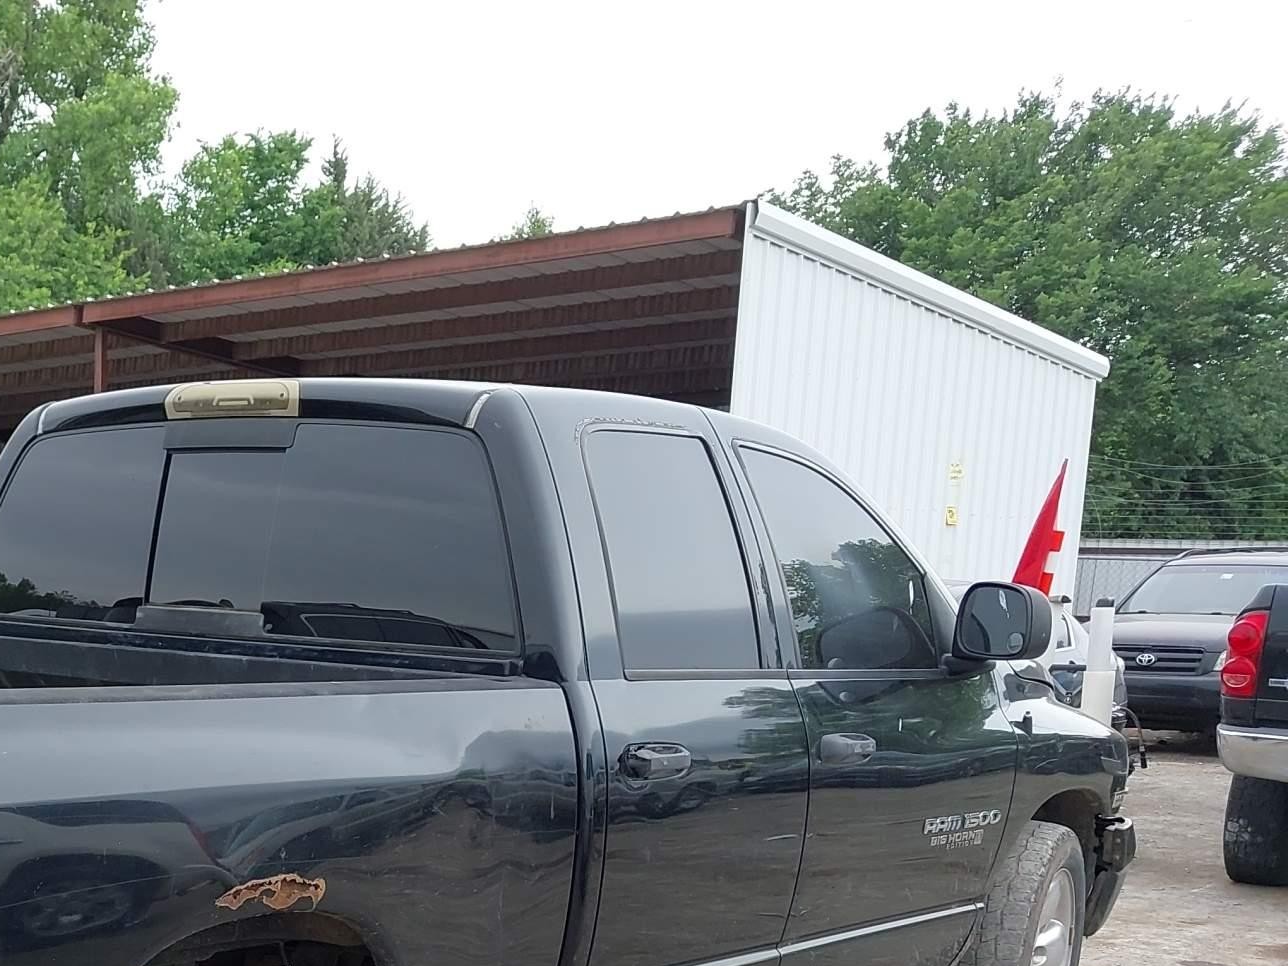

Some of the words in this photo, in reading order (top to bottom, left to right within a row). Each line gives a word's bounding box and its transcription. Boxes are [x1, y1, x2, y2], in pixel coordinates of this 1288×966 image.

[924, 815, 962, 834] RAM
[963, 809, 1002, 829] 1500
[948, 830, 974, 844] HORN
